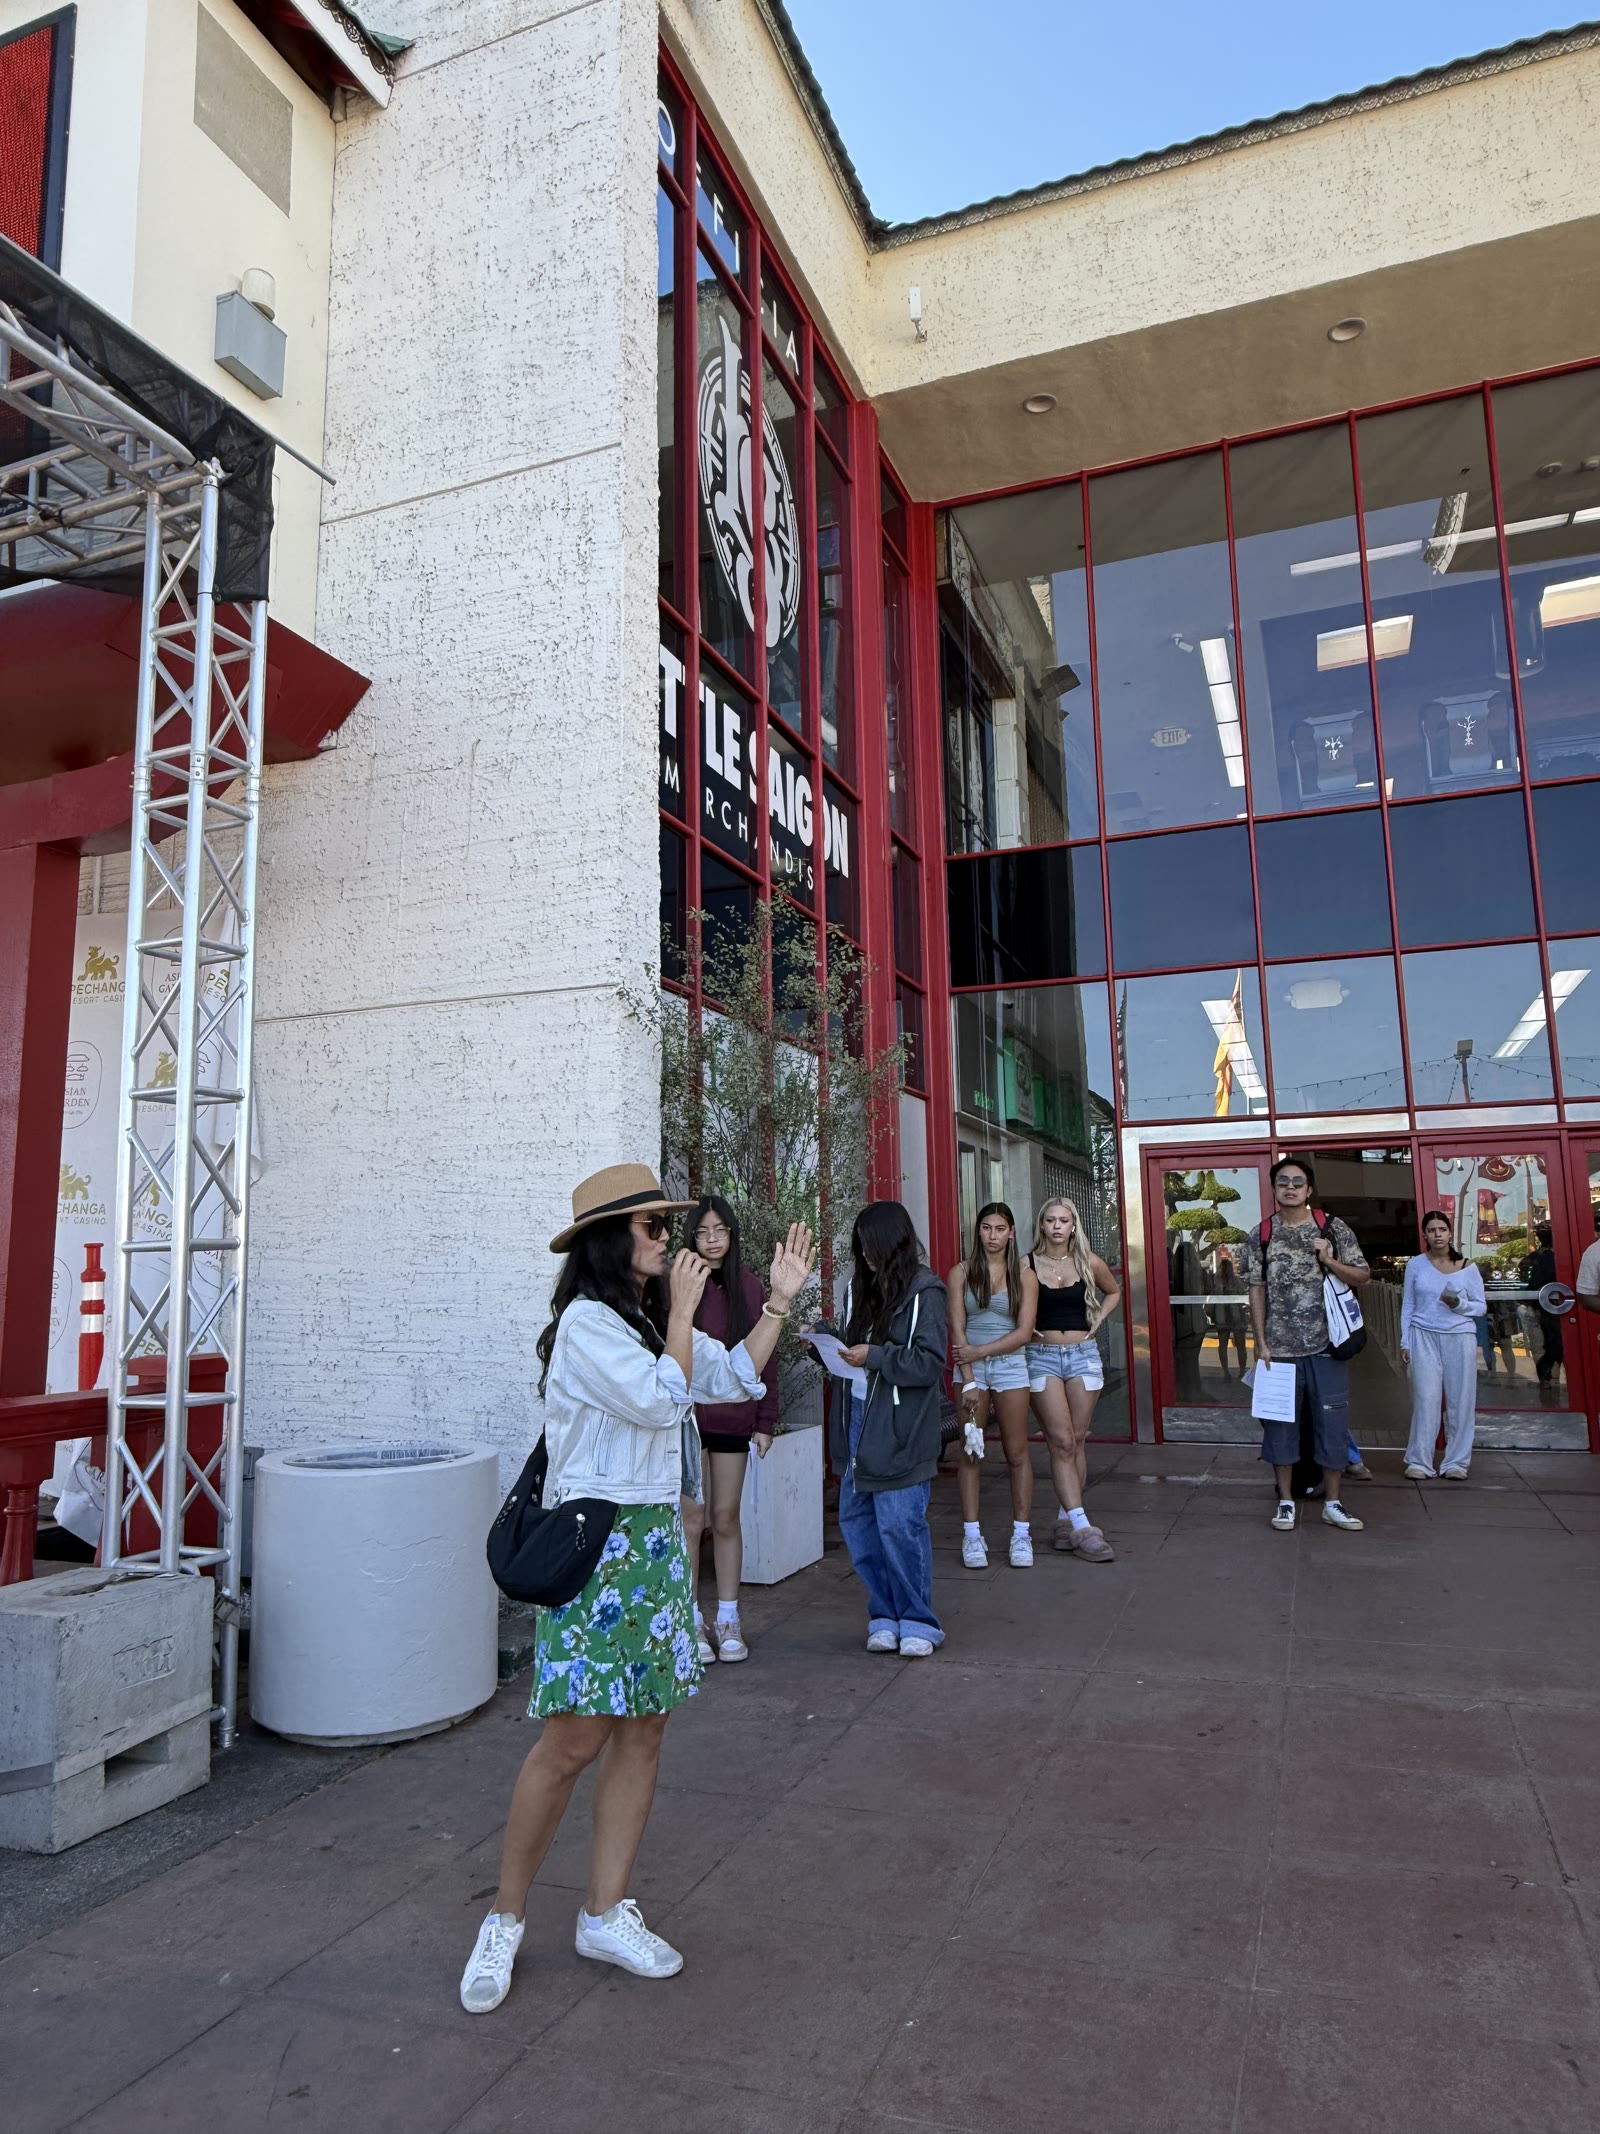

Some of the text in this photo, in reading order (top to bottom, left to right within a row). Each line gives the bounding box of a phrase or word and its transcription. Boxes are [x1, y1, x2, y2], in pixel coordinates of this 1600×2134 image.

[658, 100, 800, 376] OFIIA
[660, 643, 742, 791] TLE
[664, 754, 814, 891] MRCHNDIS
[72, 995, 100, 1005] ESORT
